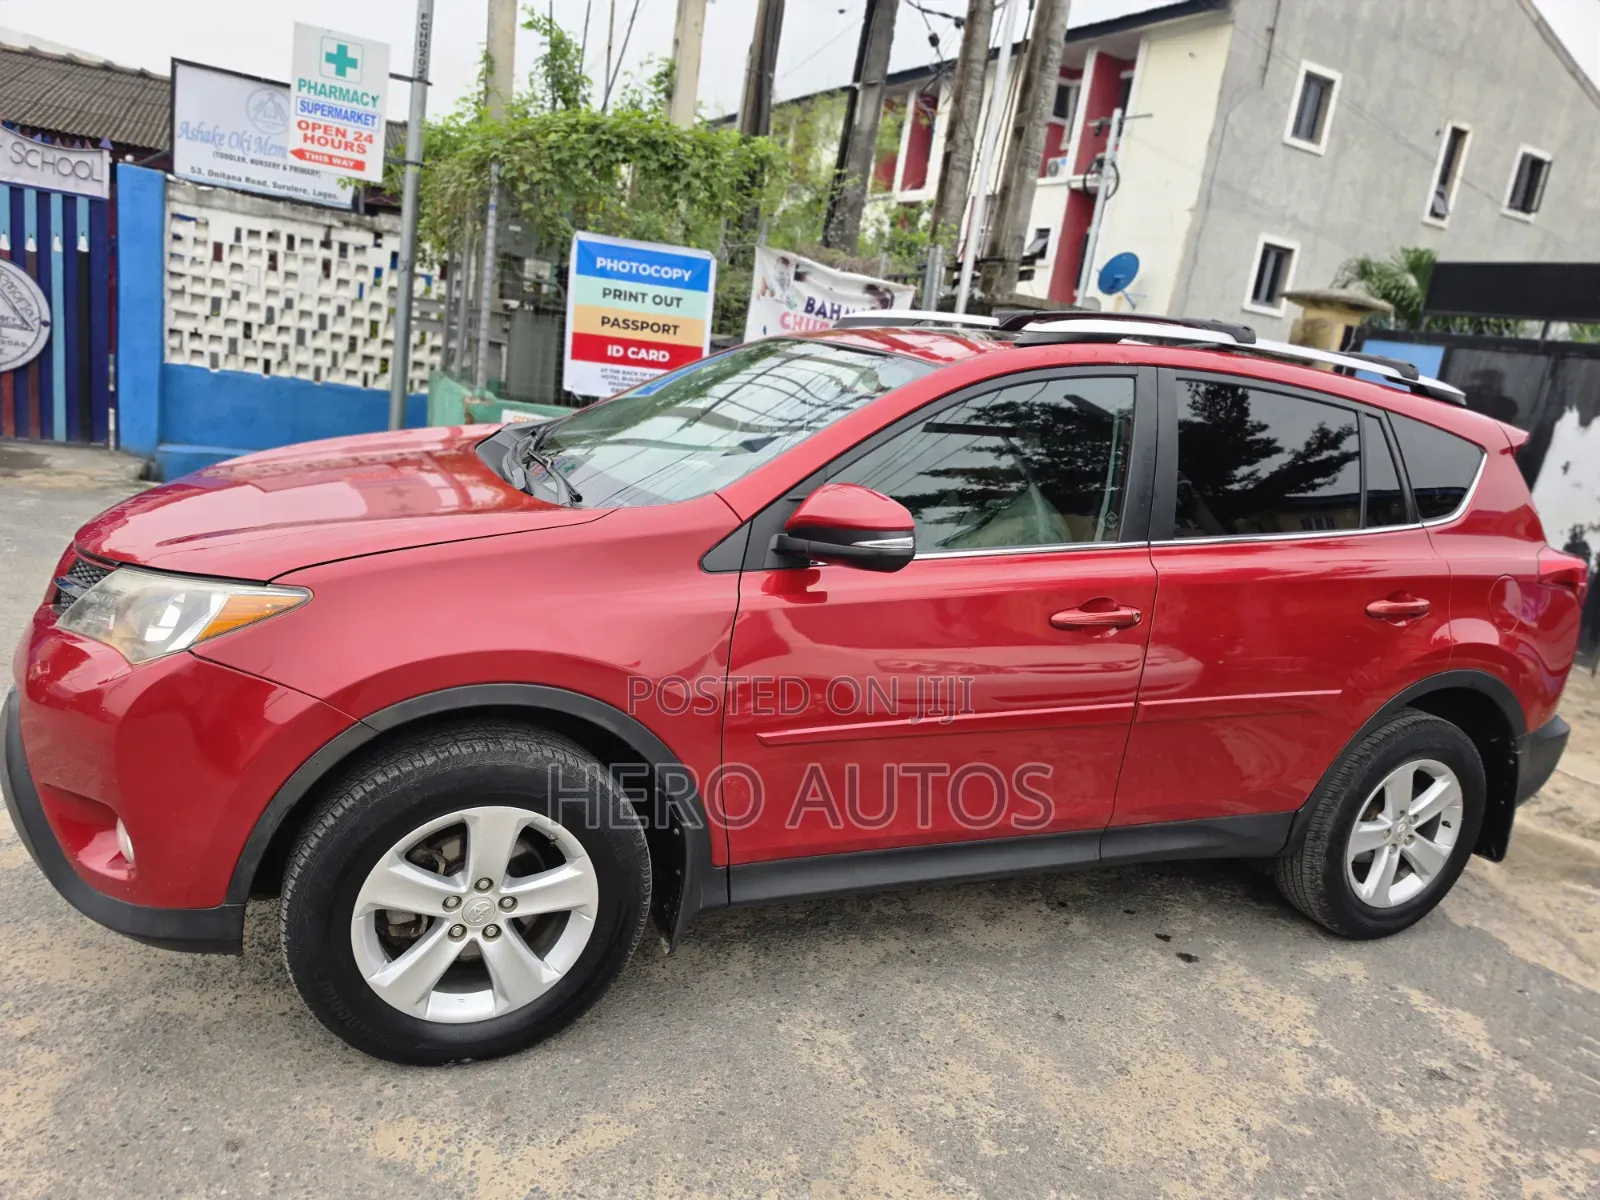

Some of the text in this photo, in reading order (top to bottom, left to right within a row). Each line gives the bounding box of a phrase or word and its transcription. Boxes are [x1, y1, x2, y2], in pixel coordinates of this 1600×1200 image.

[297, 78, 380, 108] PHARMACY
[299, 99, 377, 127] SUPERMARKET
[297, 120, 374, 145] OPEN 24
[303, 133, 367, 155] HOURS
[9, 141, 103, 183] SCHOOL
[250, 157, 281, 170] NURSERY
[304, 151, 356, 169] THIS WAY
[207, 168, 243, 183] Onitana
[595, 256, 692, 283] PHOTOCOPY
[602, 286, 684, 309] PRINT OUT
[601, 315, 680, 336] PASSPORT
[607, 344, 671, 363] ID CARD
